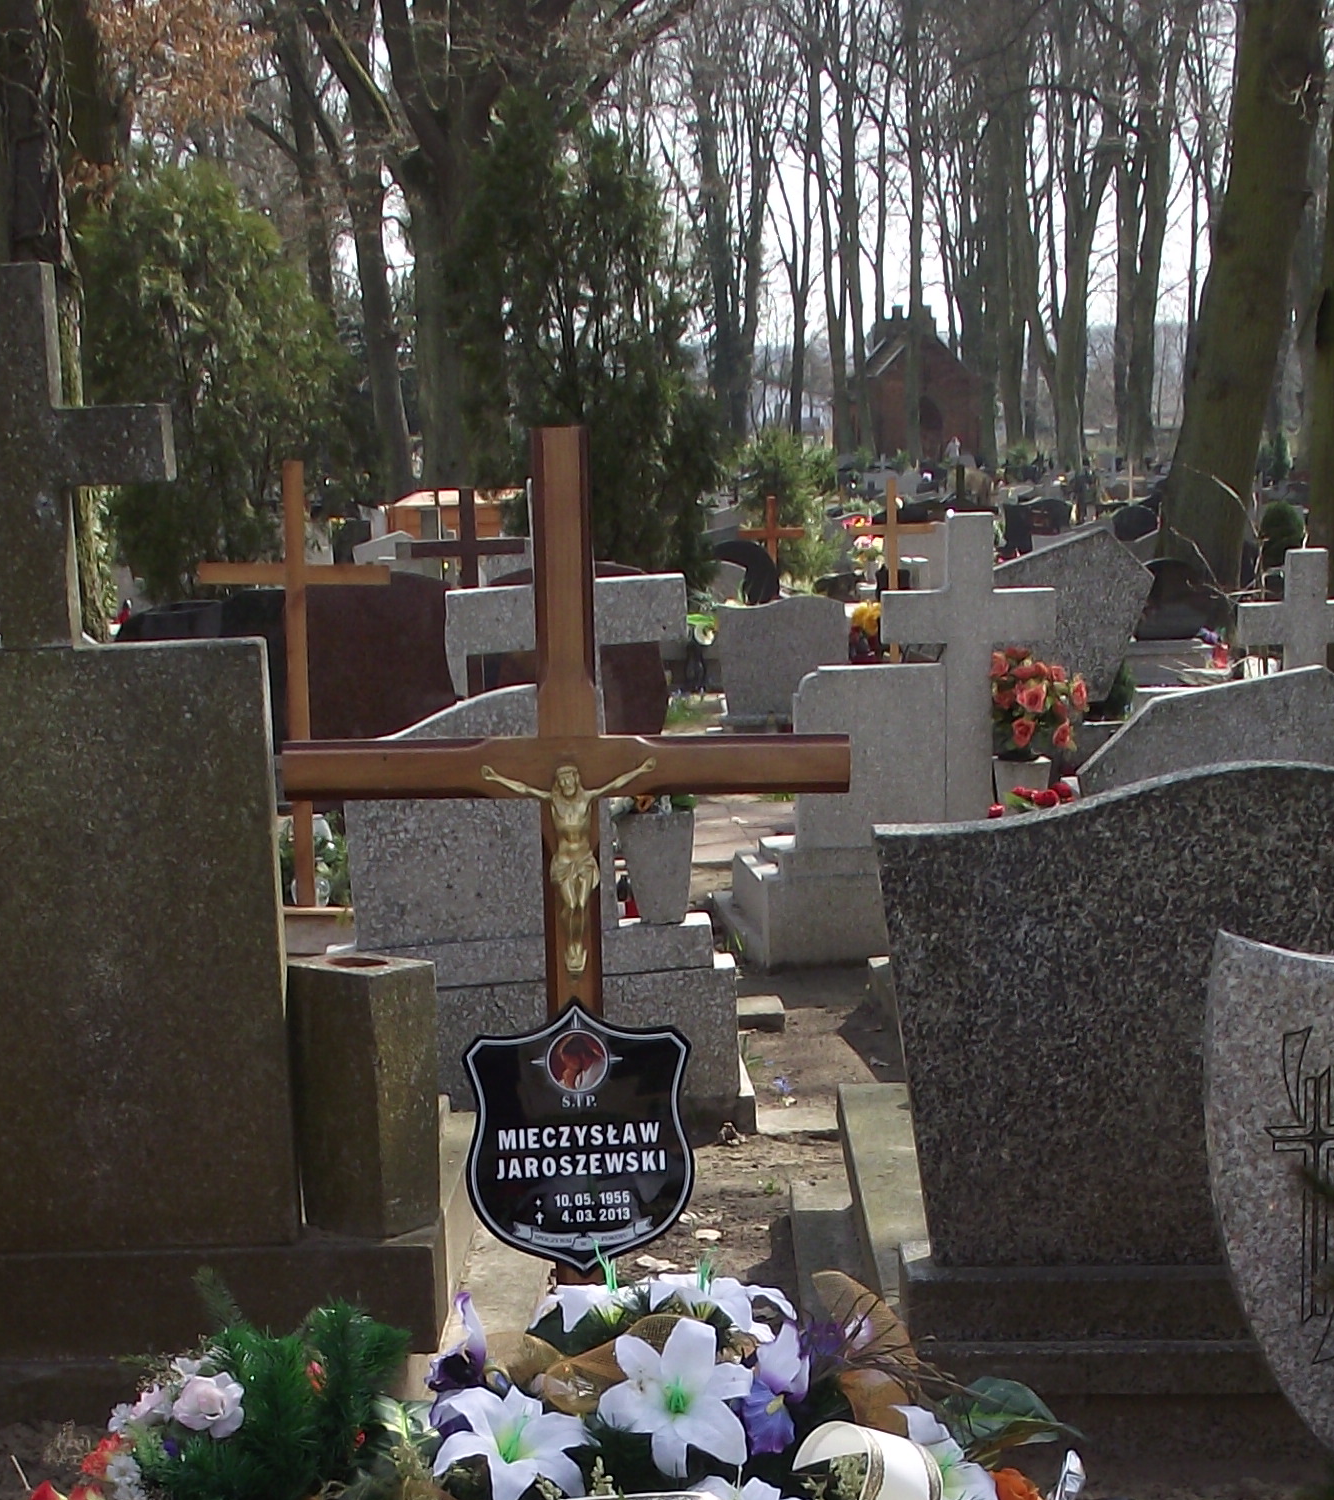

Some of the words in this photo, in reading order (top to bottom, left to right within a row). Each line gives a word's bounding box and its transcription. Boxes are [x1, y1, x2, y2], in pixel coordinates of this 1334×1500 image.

[497, 1121, 660, 1150] MIECZYSŁAW
[496, 1150, 667, 1180] JAROSZEWSKI
[599, 1207, 631, 1222] 2013
